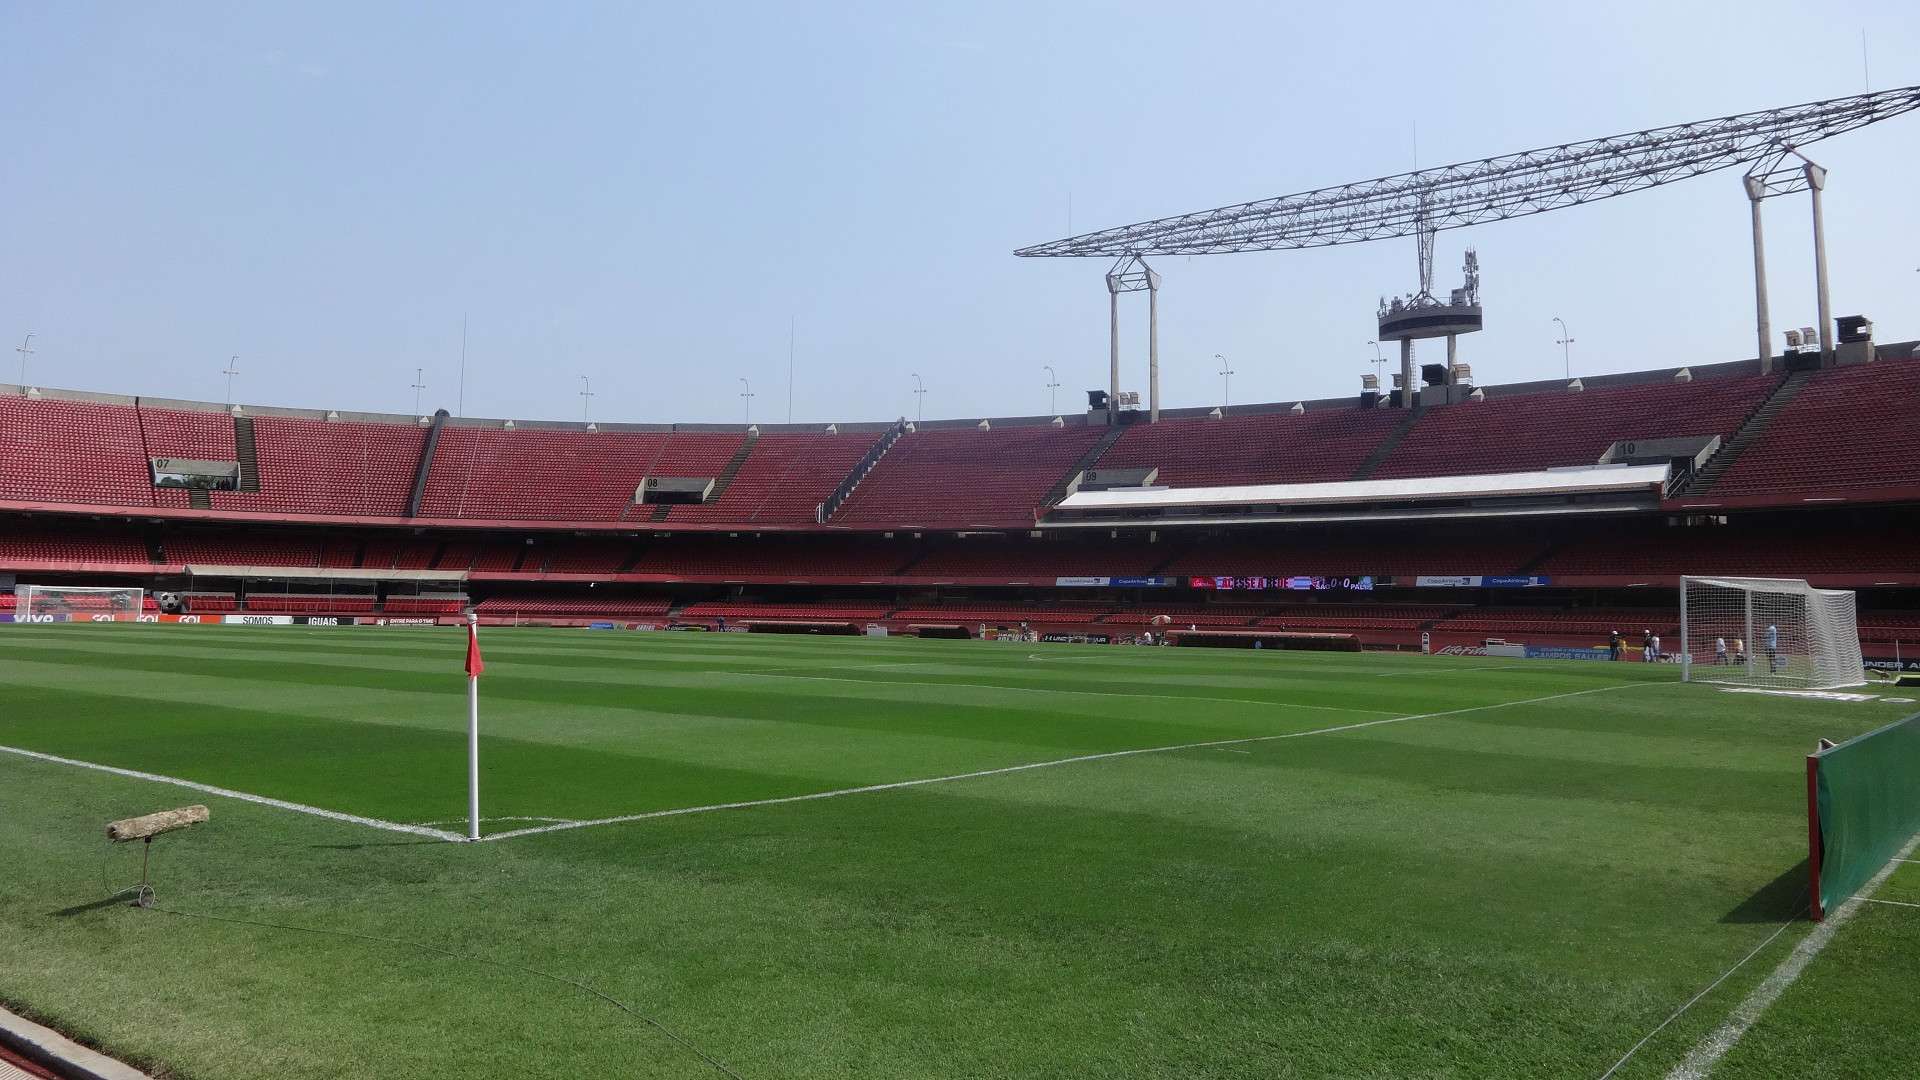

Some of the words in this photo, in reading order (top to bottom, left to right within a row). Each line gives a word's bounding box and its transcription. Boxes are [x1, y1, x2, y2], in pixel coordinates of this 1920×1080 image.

[1620, 443, 1635, 455] 10
[156, 459, 170, 469] 07
[1086, 471, 1097, 481] 09
[647, 478, 658, 487] 08
[242, 616, 273, 624] SOMOS
[307, 617, 338, 626] IGUAIS
